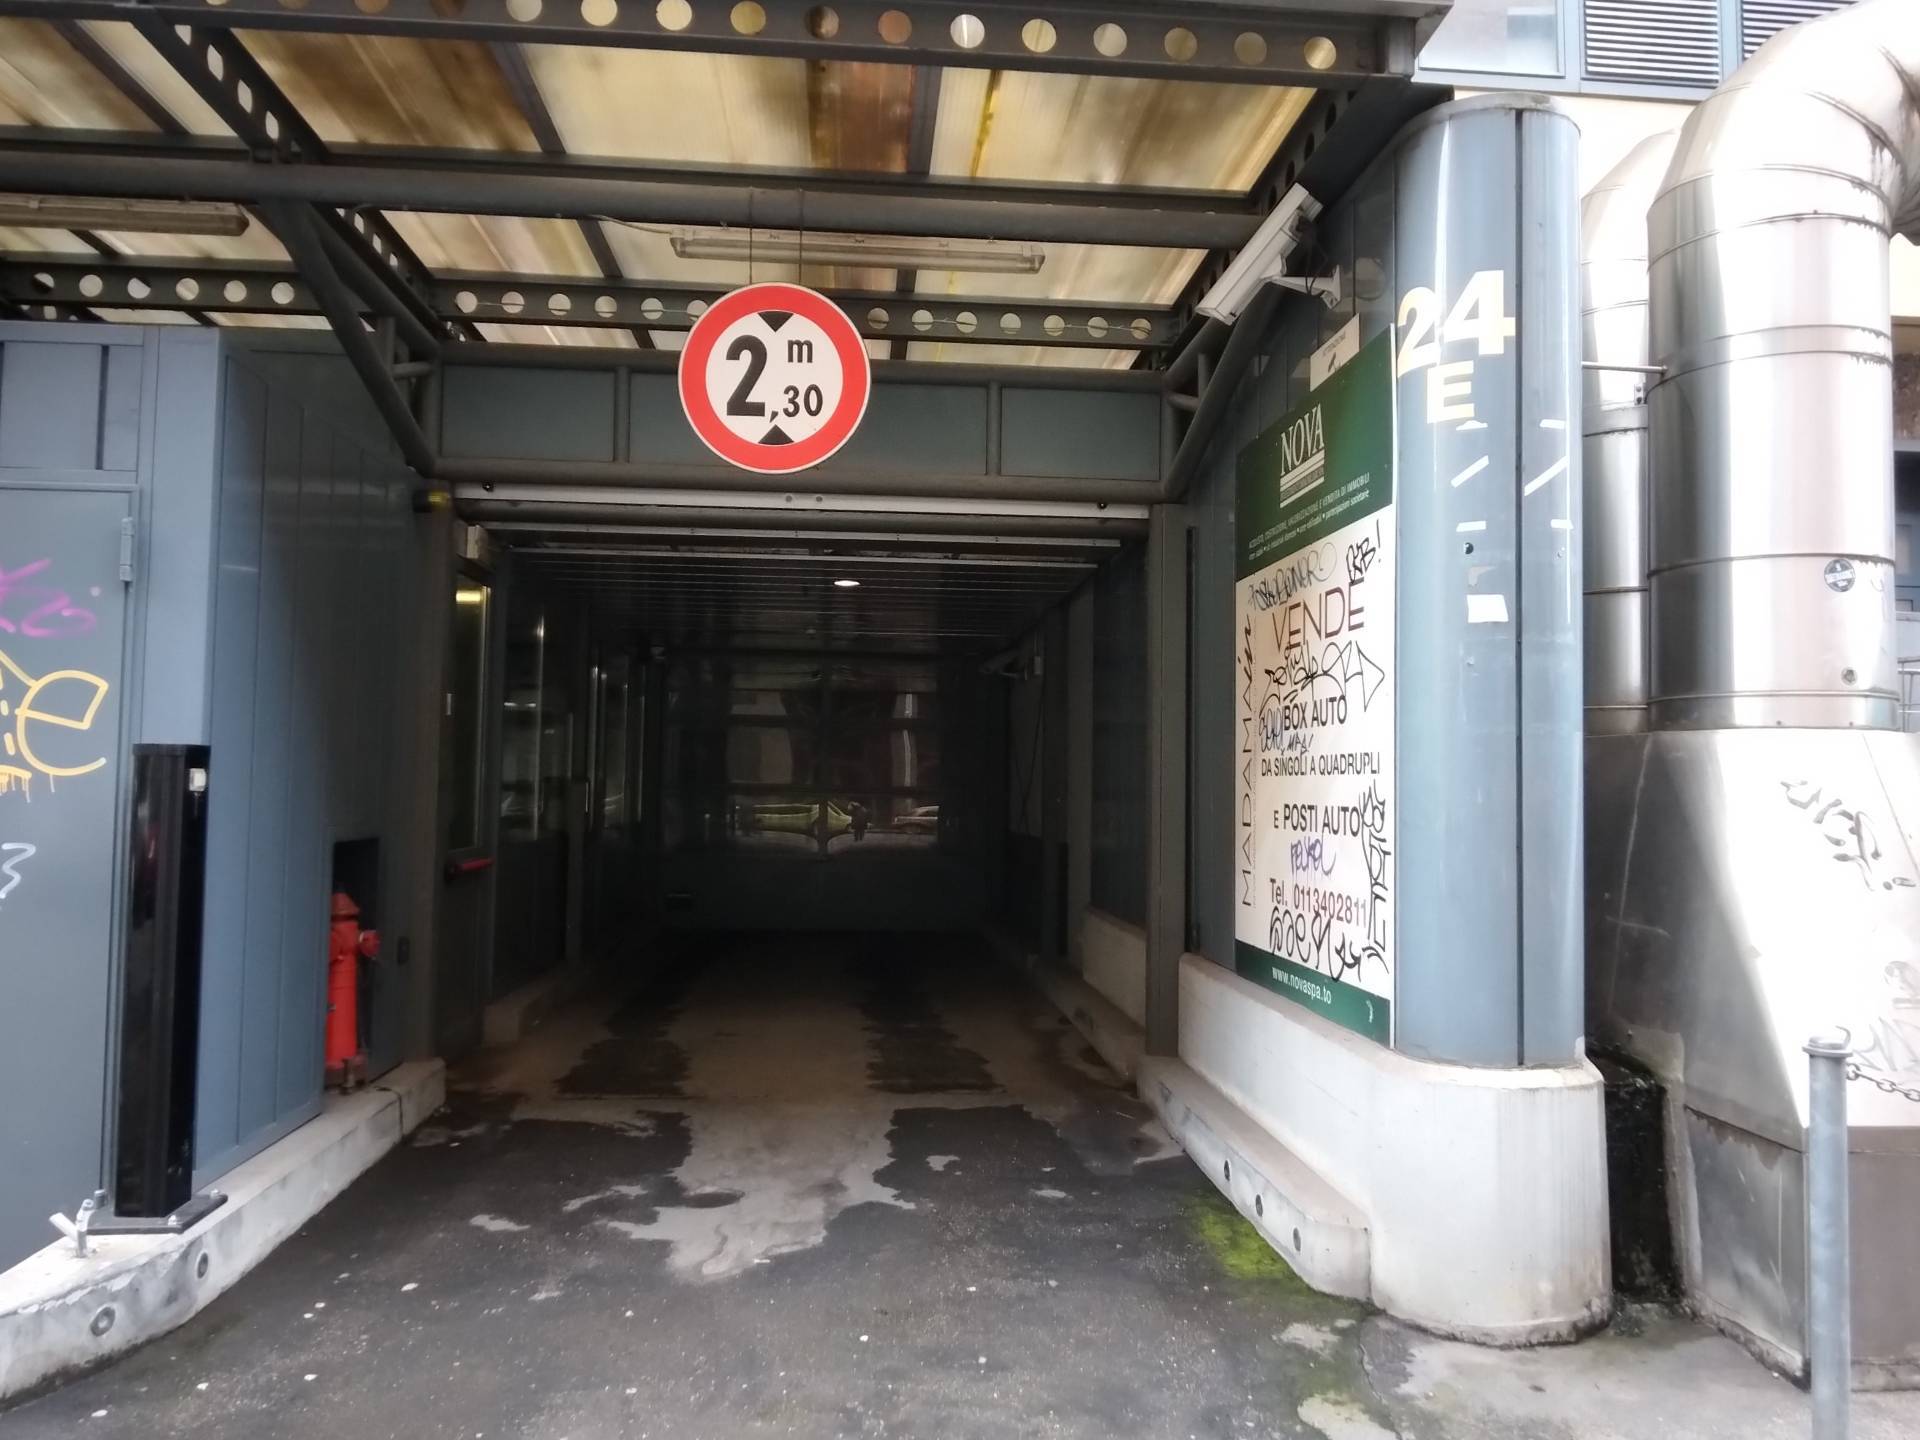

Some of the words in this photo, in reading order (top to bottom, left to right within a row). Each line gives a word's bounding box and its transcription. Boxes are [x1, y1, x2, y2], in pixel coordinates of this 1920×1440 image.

[1397, 270, 1516, 378] 24
[787, 339, 813, 364] m
[1427, 360, 1475, 424] E
[1280, 403, 1325, 476] NOVA
[1347, 471, 1370, 493] IMMOBILI
[1272, 576, 1365, 653] VENDE
[1284, 701, 1308, 731] BOX
[1311, 695, 1348, 728] AUTO
[1262, 758, 1272, 777] DA
[1273, 755, 1307, 776] SINGOLI
[1310, 756, 1316, 776] A
[1319, 752, 1380, 776] QUADRUPLI
[1274, 810, 1279, 829] E
[1284, 803, 1318, 833] POSTI
[1322, 805, 1361, 837] AUTO
[1270, 877, 1288, 906] Tel.
[1293, 883, 1367, 928] 0113402811
[1272, 966, 1332, 1005] www.novaspa.to
